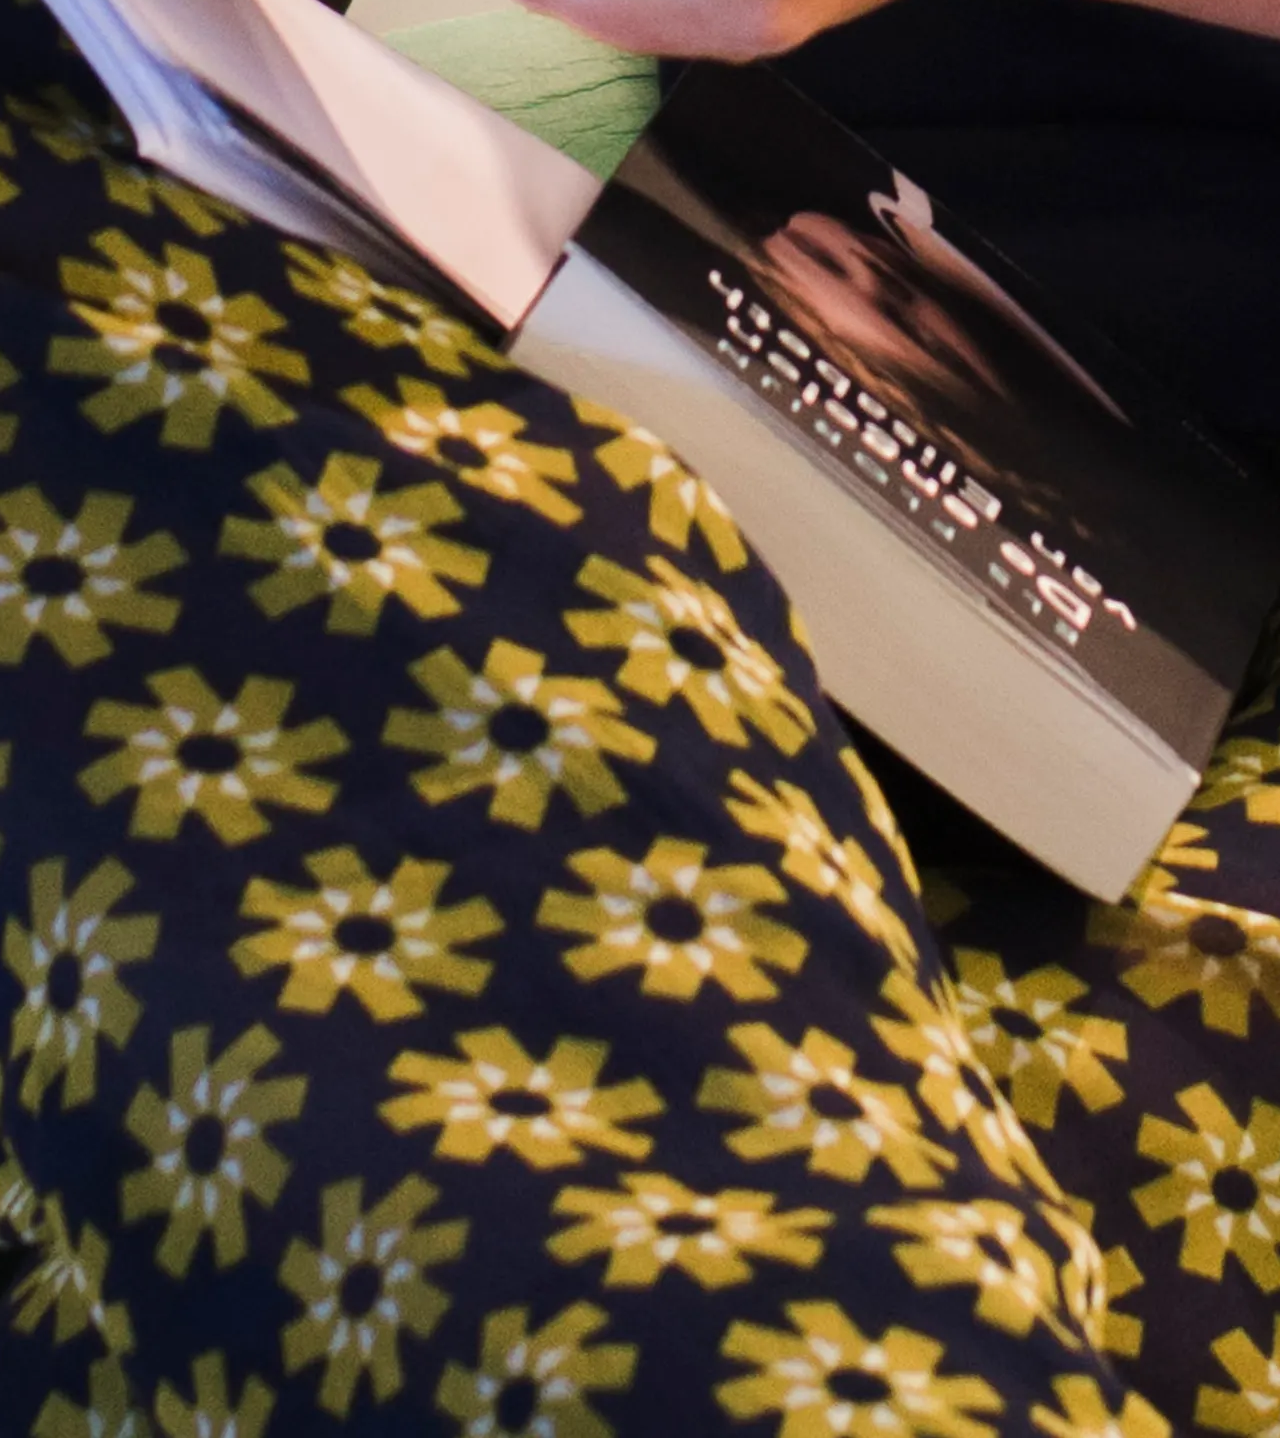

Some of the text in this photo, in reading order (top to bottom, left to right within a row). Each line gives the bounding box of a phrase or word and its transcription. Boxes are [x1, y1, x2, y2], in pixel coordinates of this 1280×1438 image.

[708, 268, 1138, 631] van Elisabeth
[726, 314, 1093, 630] De engelen
